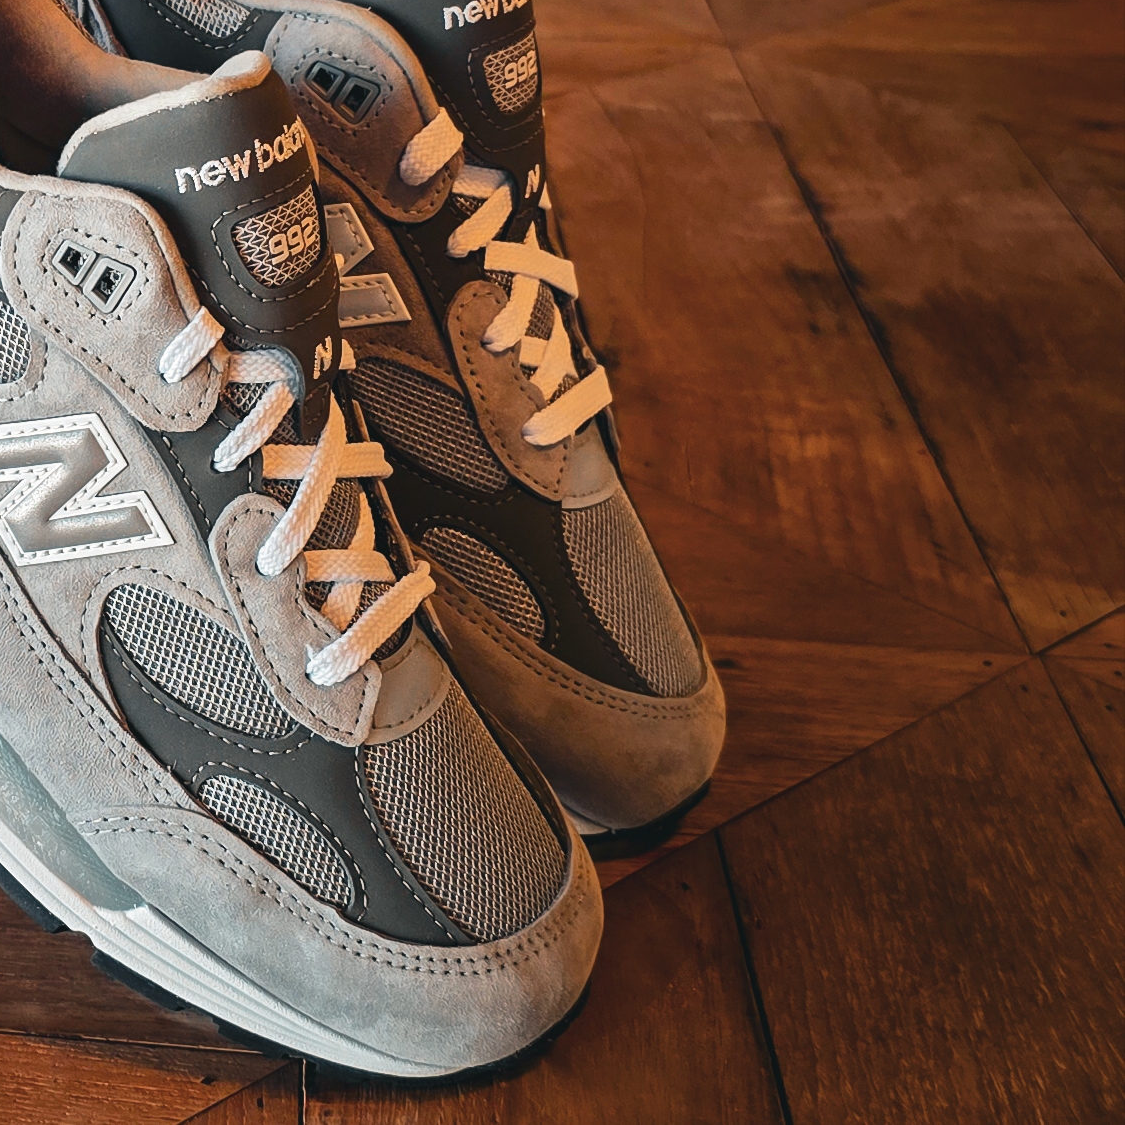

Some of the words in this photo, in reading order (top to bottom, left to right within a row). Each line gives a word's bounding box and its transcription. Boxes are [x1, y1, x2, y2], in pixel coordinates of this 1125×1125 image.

[504, 50, 538, 89] 992
[174, 149, 252, 195] new
[268, 216, 321, 265] 992
